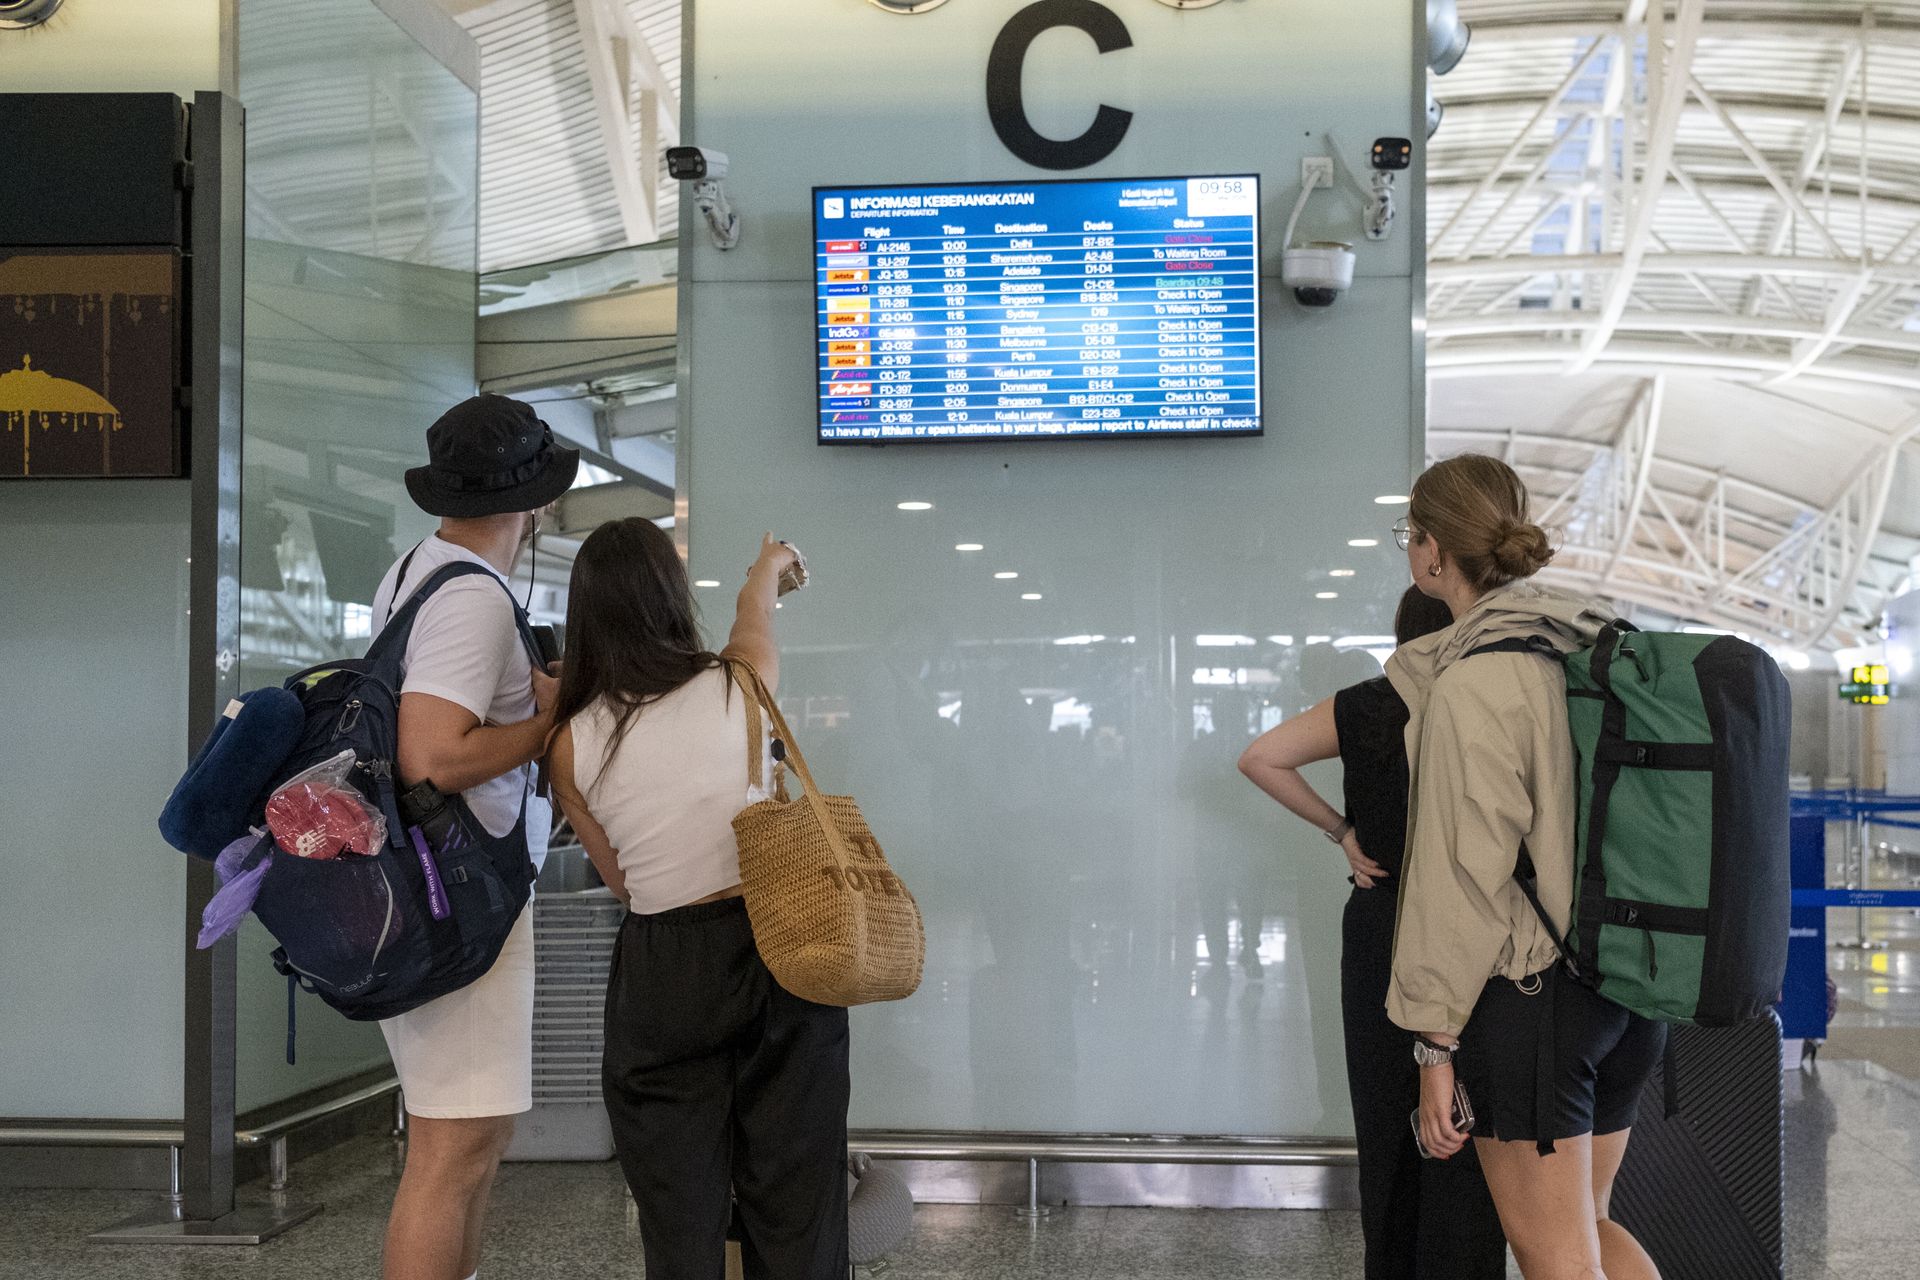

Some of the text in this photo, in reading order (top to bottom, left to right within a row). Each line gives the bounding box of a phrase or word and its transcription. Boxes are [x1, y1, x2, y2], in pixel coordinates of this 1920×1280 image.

[986, 0, 1134, 171] C
[851, 193, 1034, 210] INFORMASI KEBERANGKATAN
[851, 208, 938, 218] DEPARTURE INFORMATION
[864, 227, 890, 238] Flight
[942, 225, 965, 235] Time
[995, 223, 1047, 233] Destination
[1173, 219, 1204, 228] Status
[942, 241, 966, 250] 10:00
[1010, 239, 1032, 248] Delhi
[1083, 237, 1114, 246] B7-B12
[1165, 235, 1186, 243] Gate
[1188, 234, 1213, 242] Close
[877, 256, 910, 266] SU-297
[943, 255, 966, 264] 10:05
[1153, 249, 1164, 258] To
[1166, 248, 1200, 259] Waiting
[1200, 248, 1226, 257] Room
[944, 268, 965, 277] 10:15
[1003, 266, 1041, 276] Adelaide
[1085, 264, 1112, 273] D1-D4
[1166, 262, 1186, 270] Gate
[1189, 261, 1214, 270] Close
[1000, 282, 1044, 292] Singapore
[1084, 280, 1114, 289] C1-C12
[1156, 278, 1195, 287] Boarding
[1000, 296, 1045, 306] Singapore
[1158, 290, 1186, 299] Check
[1188, 290, 1196, 298] In
[1198, 290, 1222, 300] Open
[1006, 309, 1040, 320] Sydney
[1154, 305, 1165, 314] To
[1167, 304, 1200, 315] Waiting
[1201, 304, 1227, 312] Room
[829, 327, 859, 338] IndiGo
[1001, 325, 1045, 335] Bangalore
[1158, 321, 1187, 330] Check
[1188, 321, 1197, 329] In
[1198, 320, 1222, 330] Open
[1000, 338, 1047, 347] Melbourne
[1158, 334, 1187, 342] Check
[1188, 334, 1197, 342] In
[1198, 333, 1223, 343] Open
[1011, 352, 1036, 361] Perth
[1159, 348, 1187, 357] Check
[1188, 348, 1197, 356] In
[1199, 347, 1223, 357] Open
[879, 370, 911, 380] OD-172
[994, 368, 1018, 377] Kuala
[1020, 368, 1053, 378] Lumpur
[1159, 364, 1188, 373] Check
[1188, 364, 1197, 372] In
[1199, 363, 1223, 373] Open
[879, 384, 912, 394] FD-397
[1088, 380, 1113, 390] E1-E4
[1159, 378, 1188, 387] Check
[1189, 378, 1197, 386] In
[1199, 377, 1223, 387] Open
[879, 398, 913, 408] SQ-937
[943, 398, 966, 407] 12:05
[998, 397, 1042, 406] Singapore
[1165, 392, 1194, 401] Check
[1196, 392, 1204, 400] In
[1205, 391, 1229, 401] Open
[880, 413, 913, 423] OD-192
[995, 410, 1020, 420] Kuala
[1021, 410, 1053, 420] Lumpur
[1160, 407, 1188, 416] Check
[1190, 407, 1198, 415] In
[1200, 406, 1224, 416] Open
[836, 426, 860, 436] have
[862, 426, 879, 438] any
[882, 424, 913, 436] lithium
[915, 426, 925, 435] or
[928, 426, 954, 436] spare
[958, 423, 1000, 434] batteries
[1004, 423, 1012, 433] in
[1014, 424, 1036, 434] your
[1038, 422, 1065, 433] bags,
[1067, 421, 1099, 433] please
[1102, 421, 1132, 432] report
[1134, 420, 1145, 430] to
[1147, 419, 1183, 430] Airlines
[1186, 418, 1208, 429] staff
[1210, 418, 1220, 428] in
[420, 852, 440, 915] WORK WITH FLAME
[821, 865, 900, 896] TOTE
